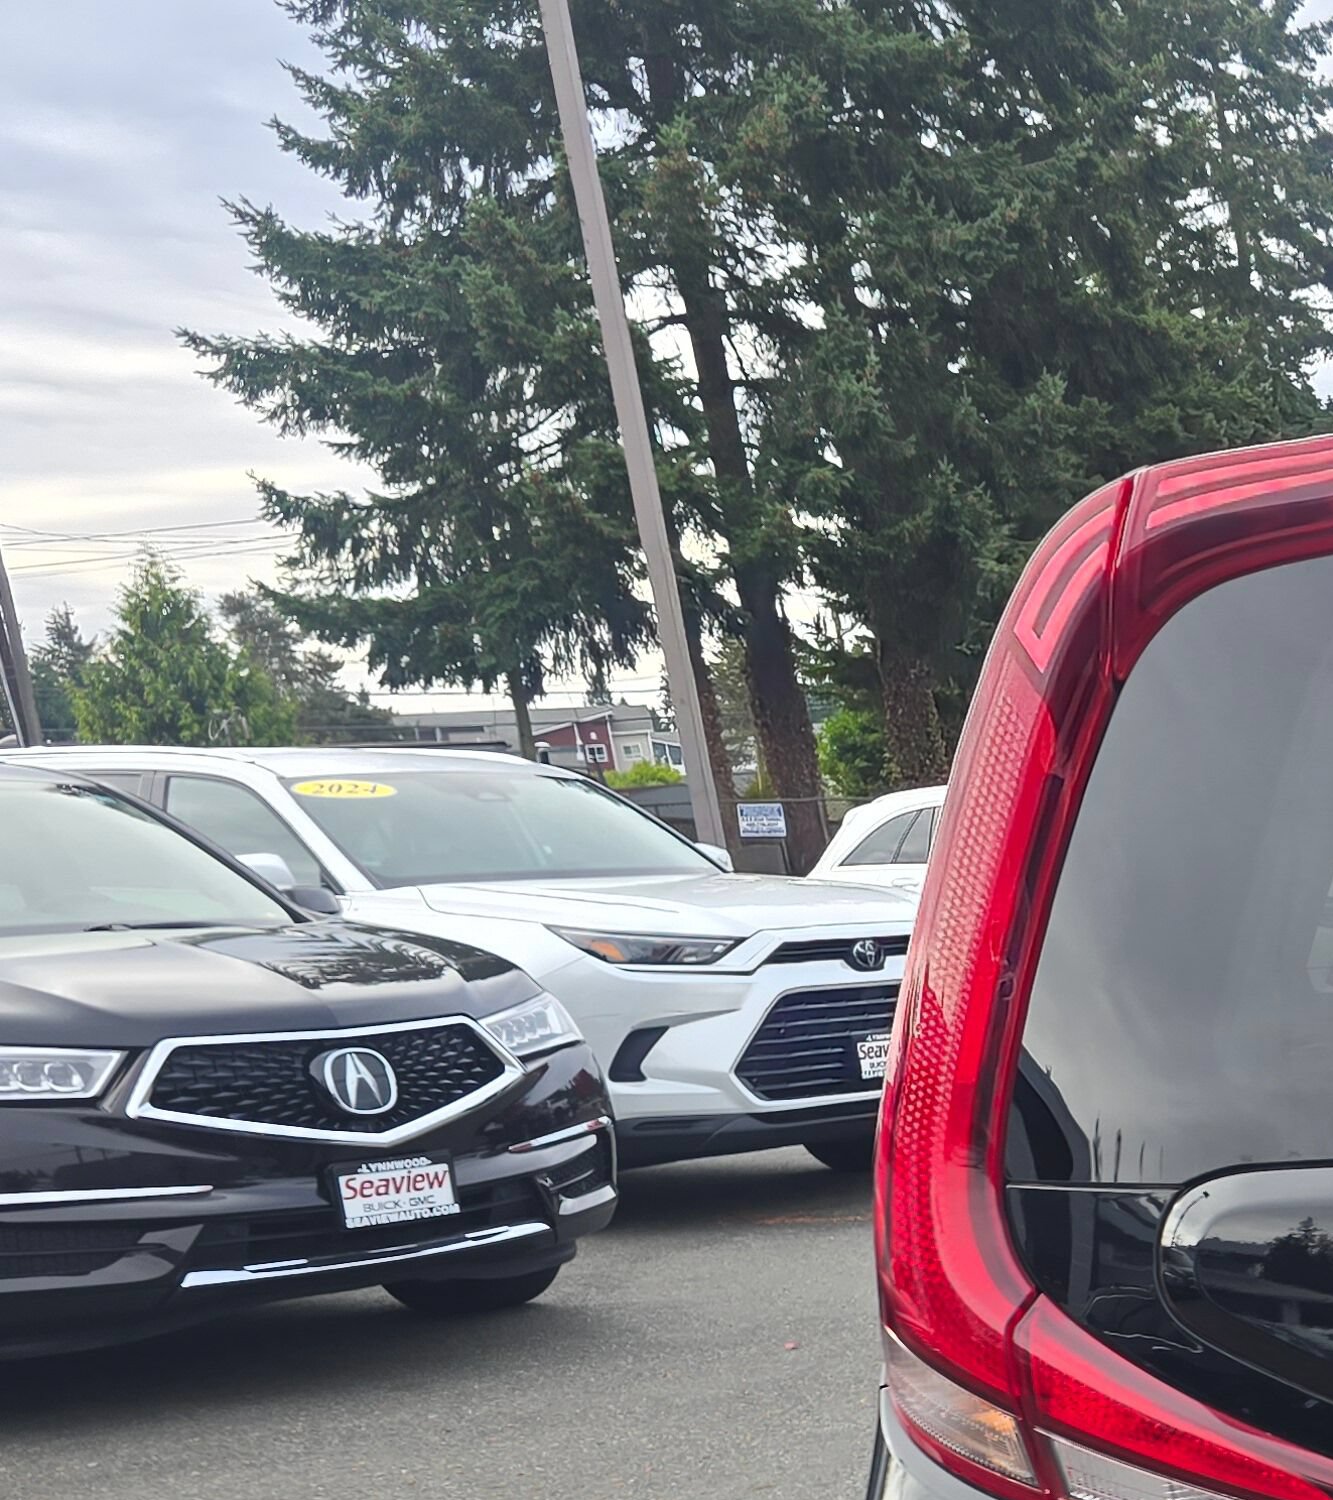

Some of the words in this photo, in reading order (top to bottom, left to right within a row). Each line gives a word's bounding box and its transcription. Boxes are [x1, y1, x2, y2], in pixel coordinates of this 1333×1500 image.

[311, 783, 378, 795] 2024
[859, 1044, 890, 1060] Seav
[357, 1156, 432, 1174] LYNNWOOD
[343, 1169, 449, 1200] Seaview
[362, 1199, 401, 1213] BUICK
